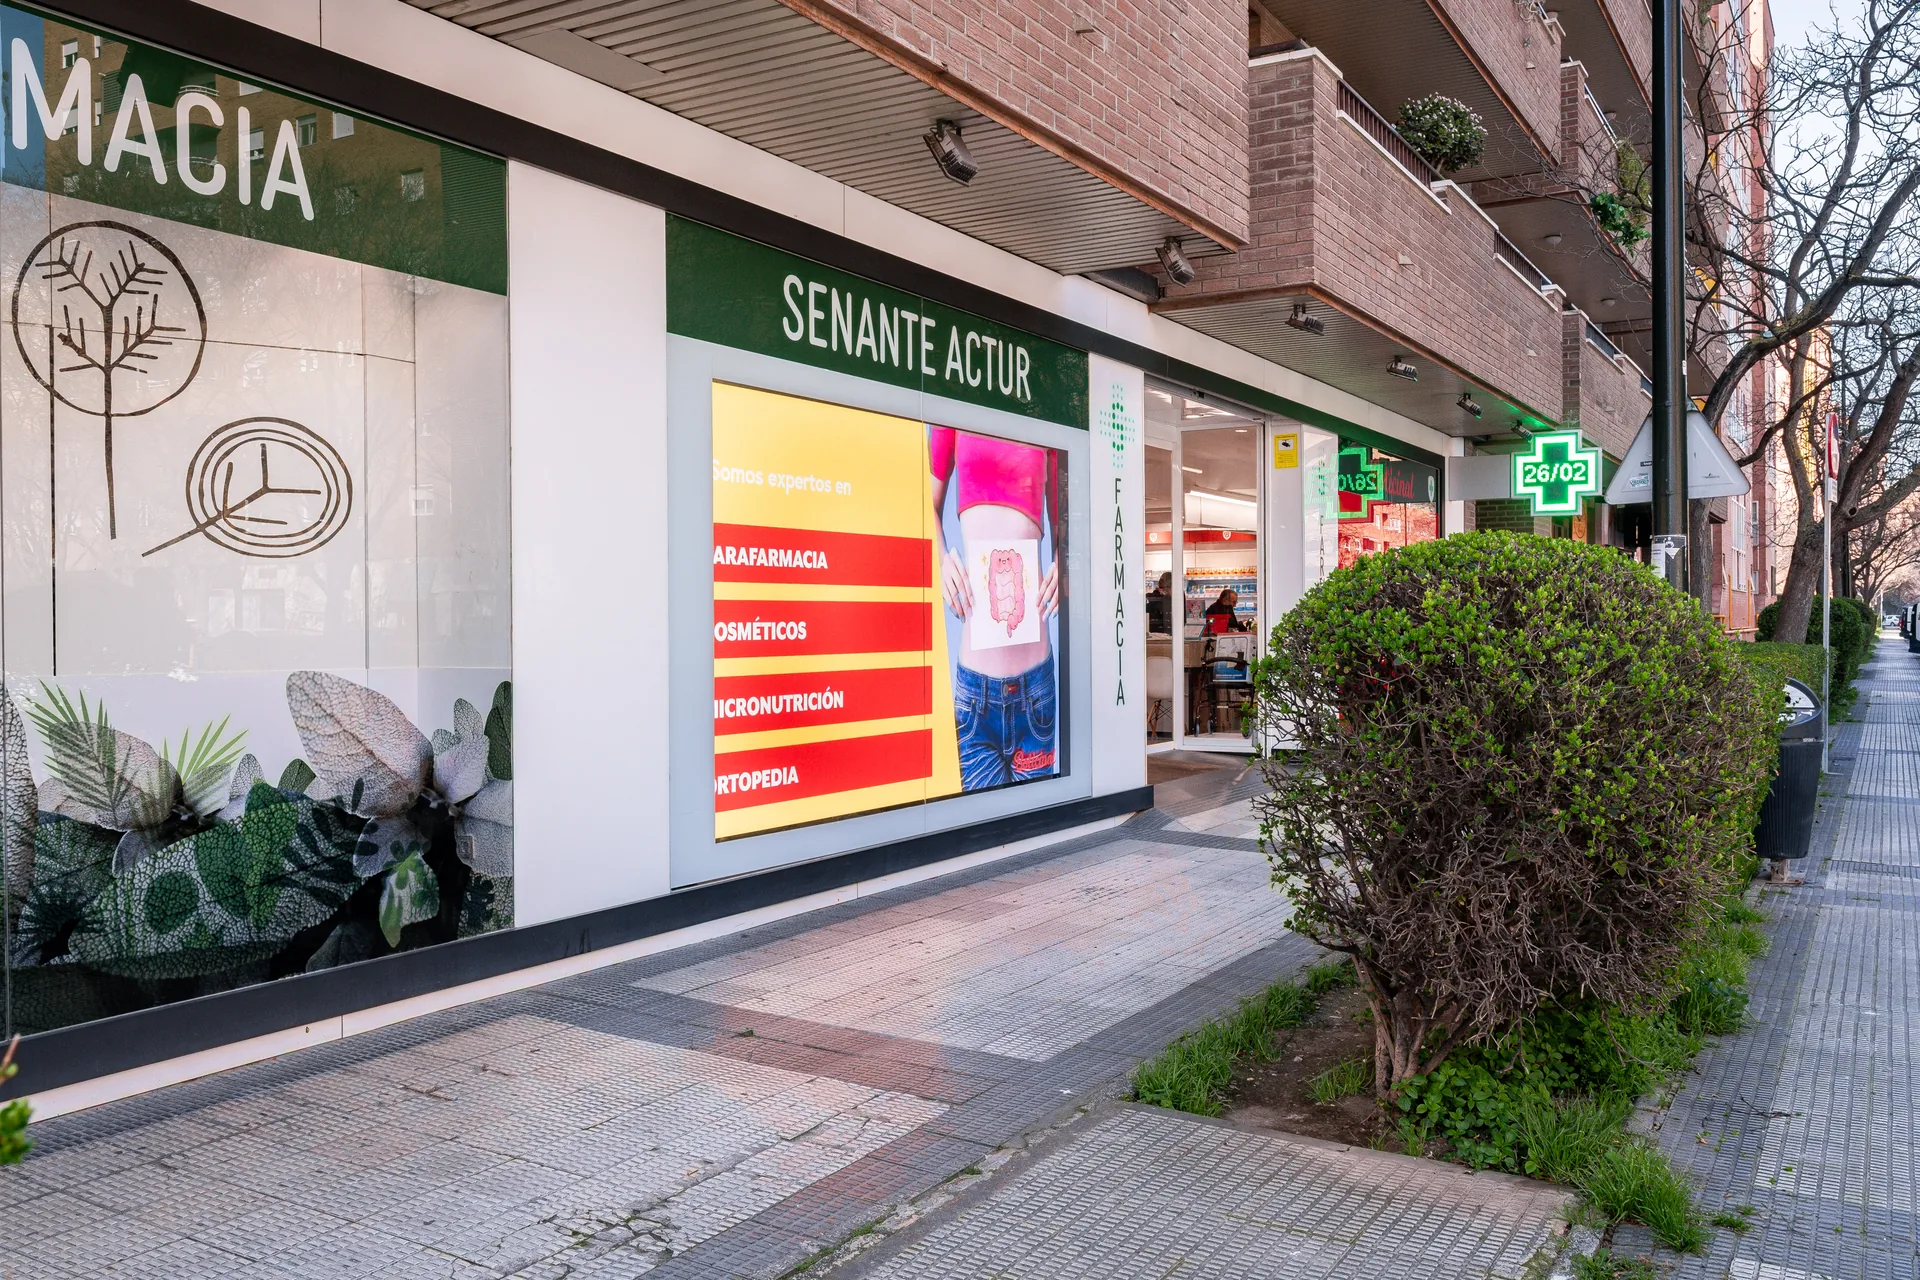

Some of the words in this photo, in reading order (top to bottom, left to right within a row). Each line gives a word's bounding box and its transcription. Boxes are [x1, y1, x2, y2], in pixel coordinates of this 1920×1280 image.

[11, 37, 315, 221] MACIA
[782, 274, 936, 376] SENANTE
[945, 325, 1031, 401] ACTUR
[713, 458, 763, 485] Somos
[767, 471, 831, 495] expertos
[835, 480, 852, 496] en
[1524, 462, 1586, 483] 26/02
[713, 545, 828, 570] ARAFARMACIA
[1114, 477, 1125, 706] FARMACIA
[714, 616, 807, 642] OSMÉTICOS
